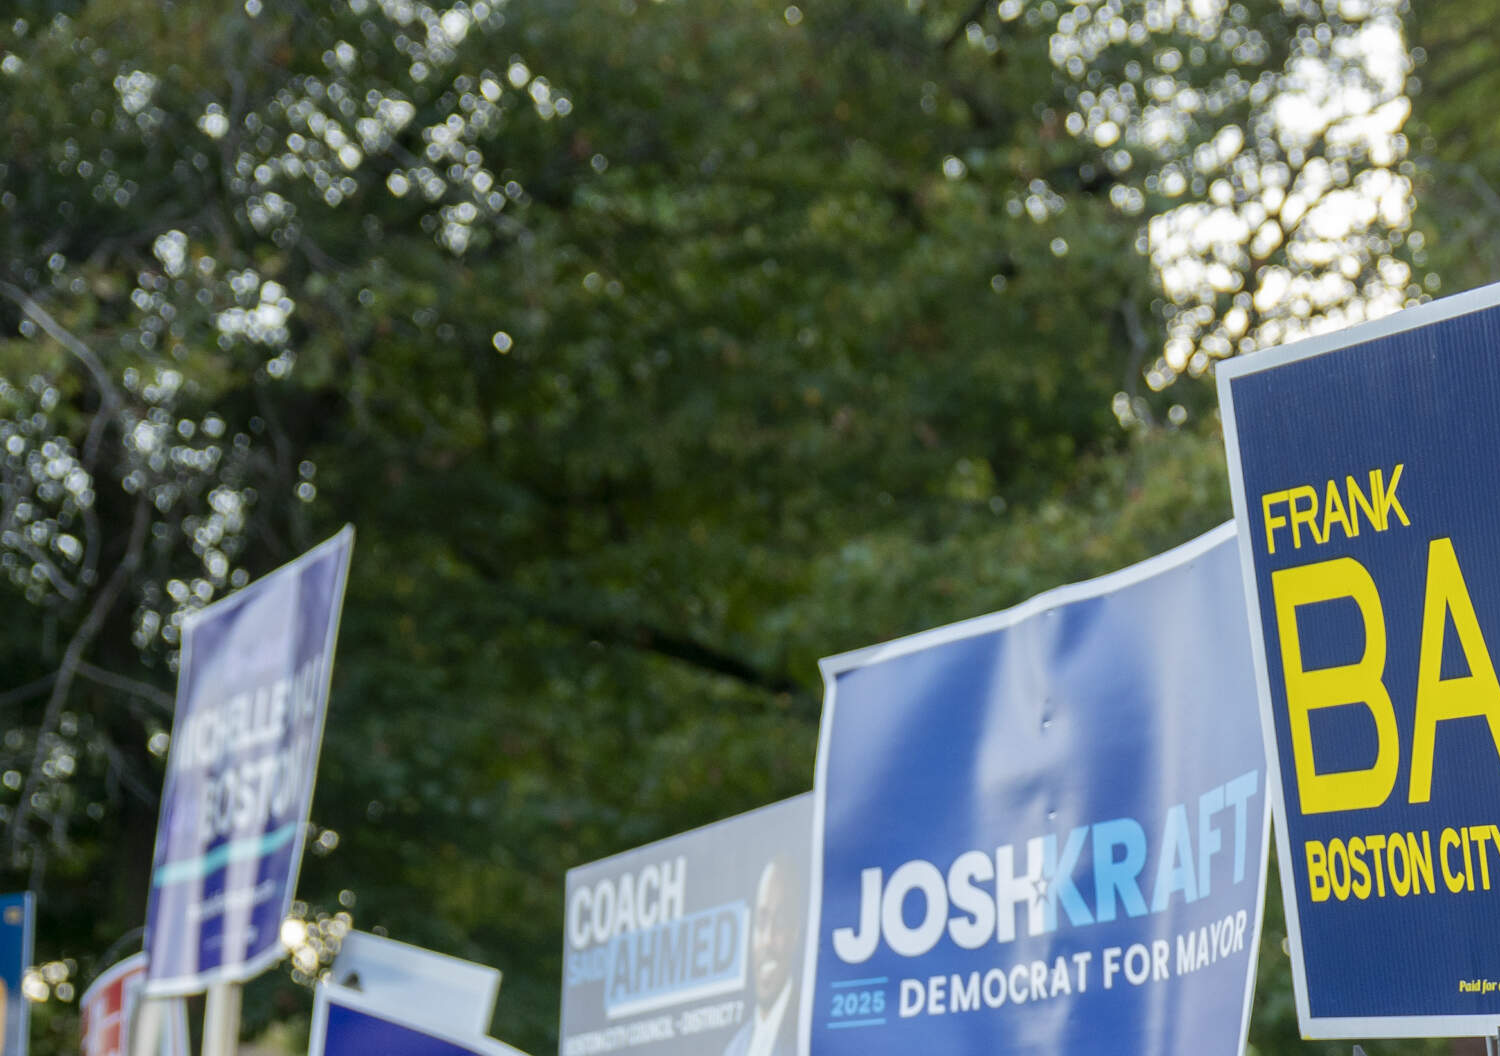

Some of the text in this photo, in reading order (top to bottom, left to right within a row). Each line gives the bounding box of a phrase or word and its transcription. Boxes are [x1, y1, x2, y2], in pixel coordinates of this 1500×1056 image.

[1262, 464, 1410, 554] FRANK
[569, 855, 687, 948] COACH
[1306, 831, 1436, 902] BOSTON
[610, 910, 738, 999] AHMED
[900, 909, 1247, 1018] DEMOCRAT FOR MAYOR
[1459, 979, 1481, 992] Paid
[1482, 979, 1497, 995] for
[831, 990, 885, 1016] 2025
